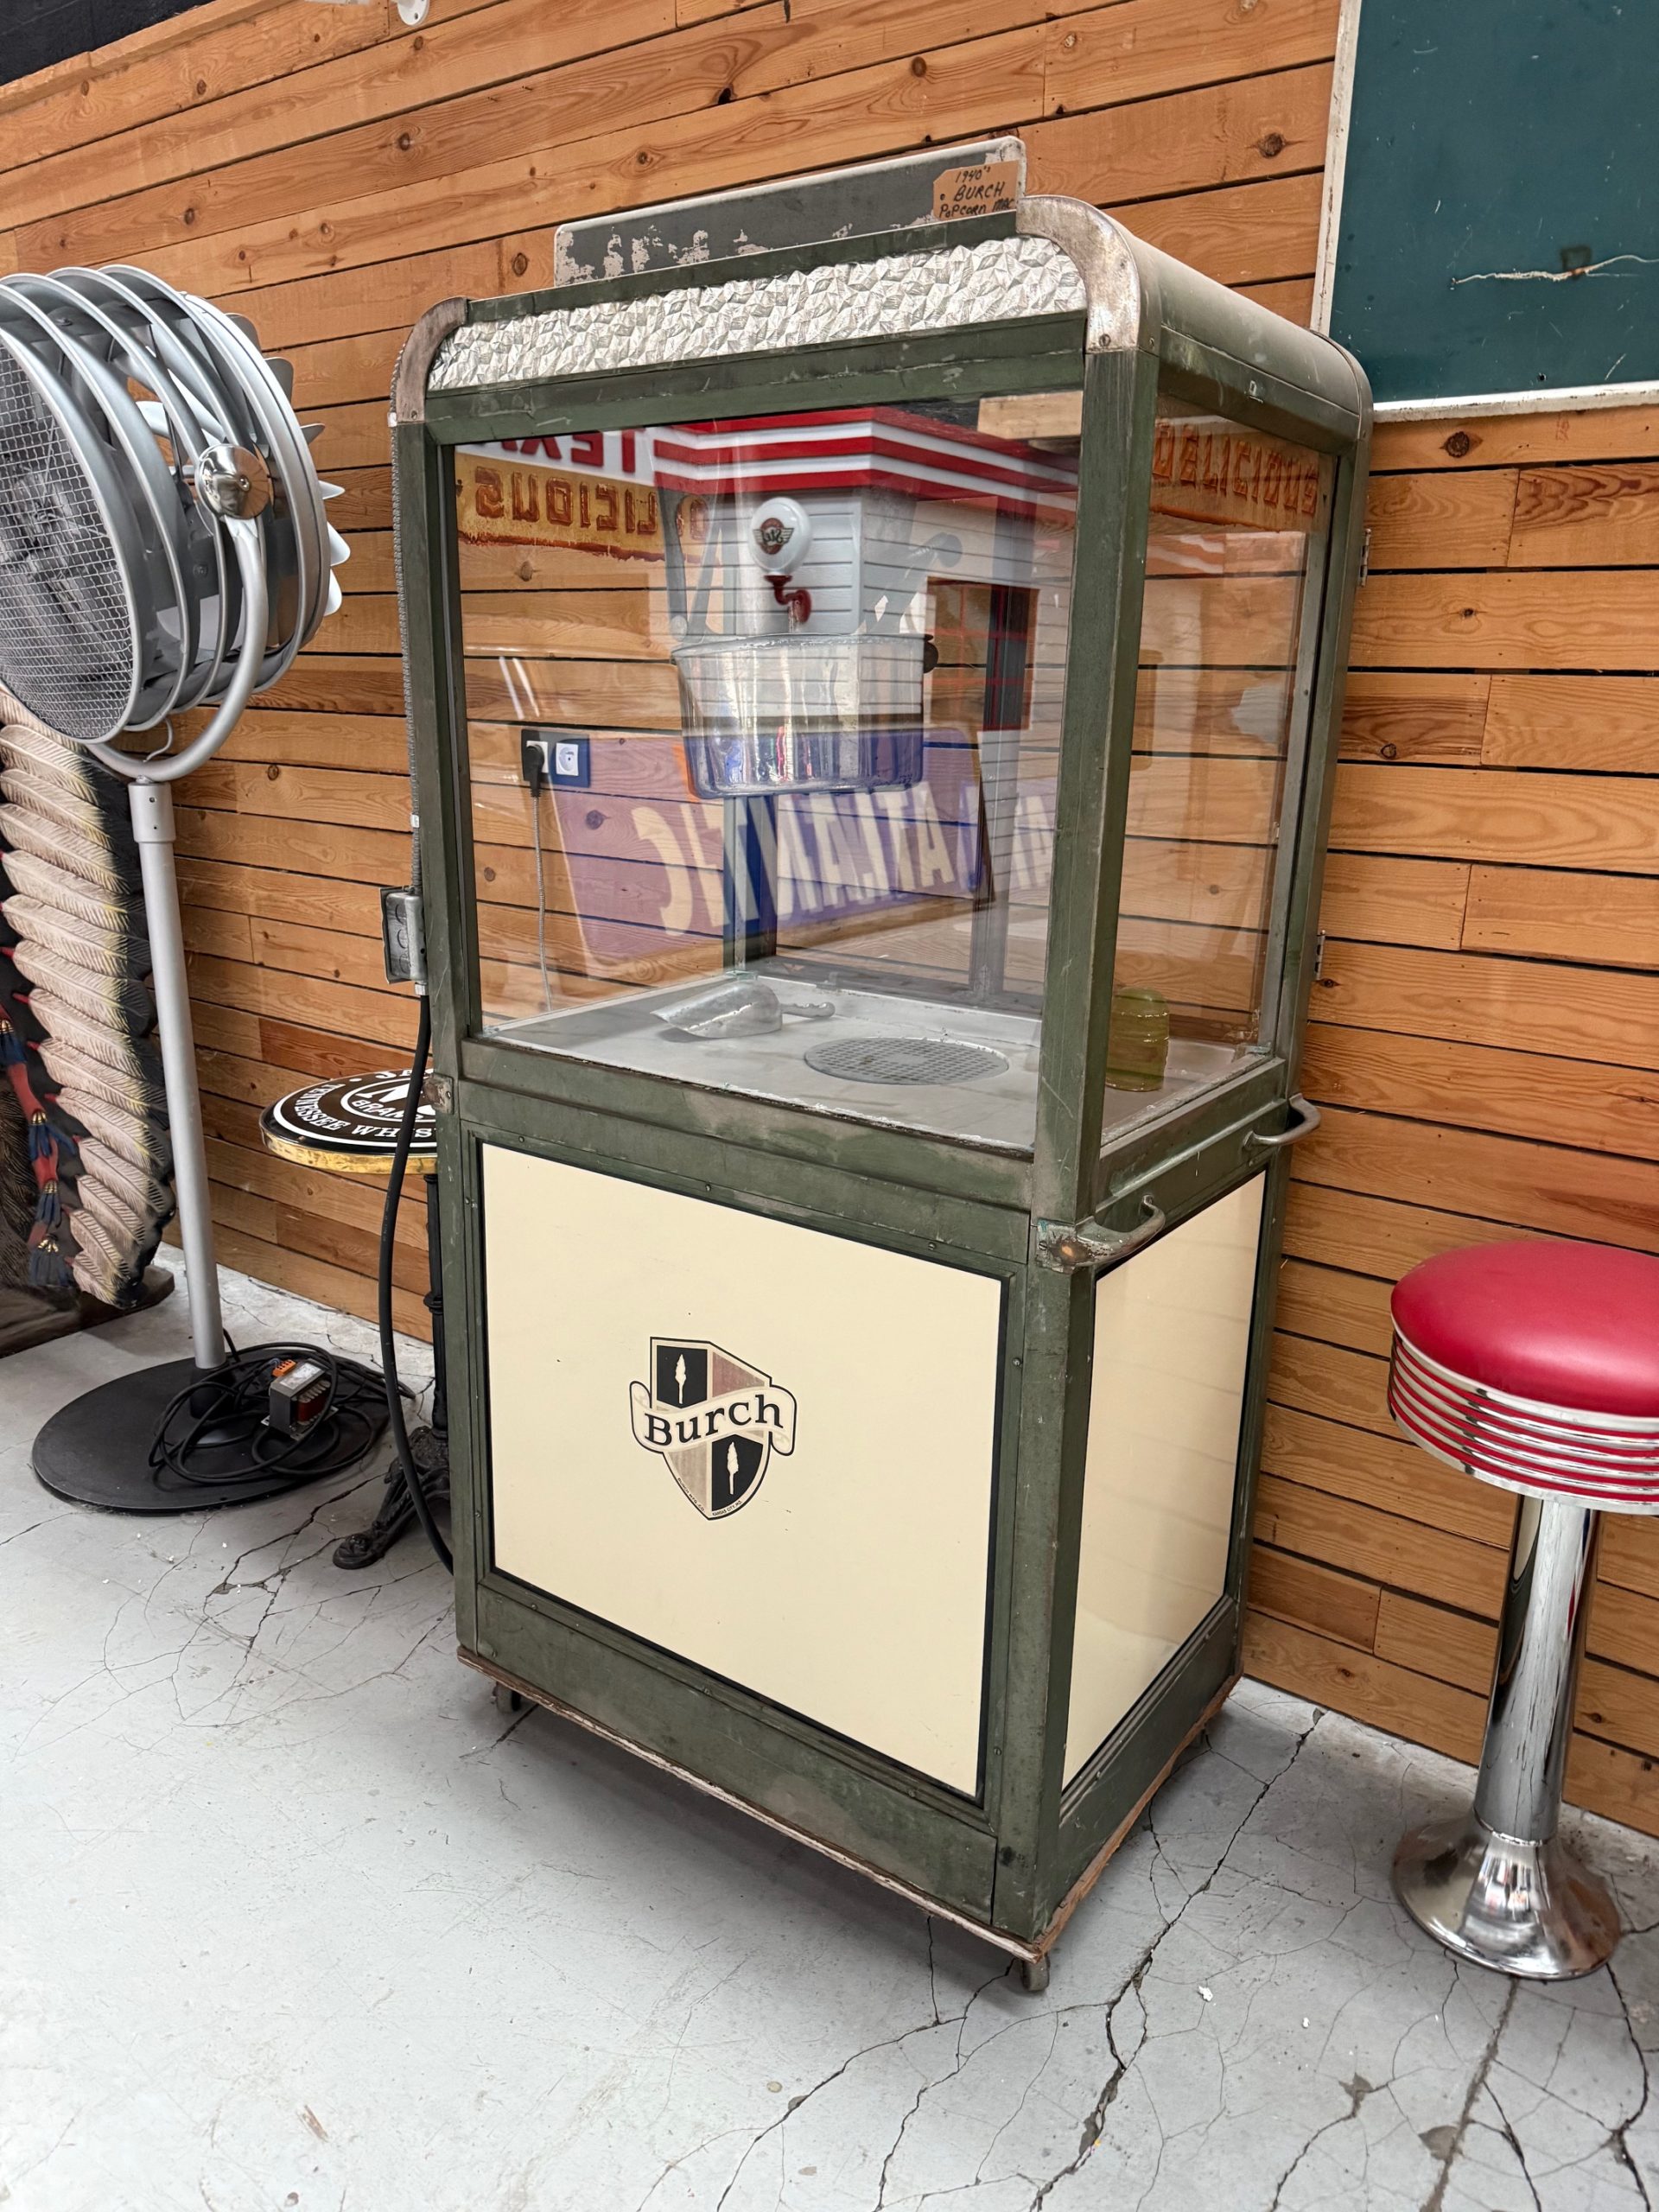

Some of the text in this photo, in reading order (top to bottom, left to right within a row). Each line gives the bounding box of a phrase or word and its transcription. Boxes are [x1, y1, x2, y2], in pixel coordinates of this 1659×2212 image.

[953, 181, 1006, 202] BURCH
[294, 1084, 352, 1131] TENNESSEE
[644, 1394, 784, 1446] Burch
